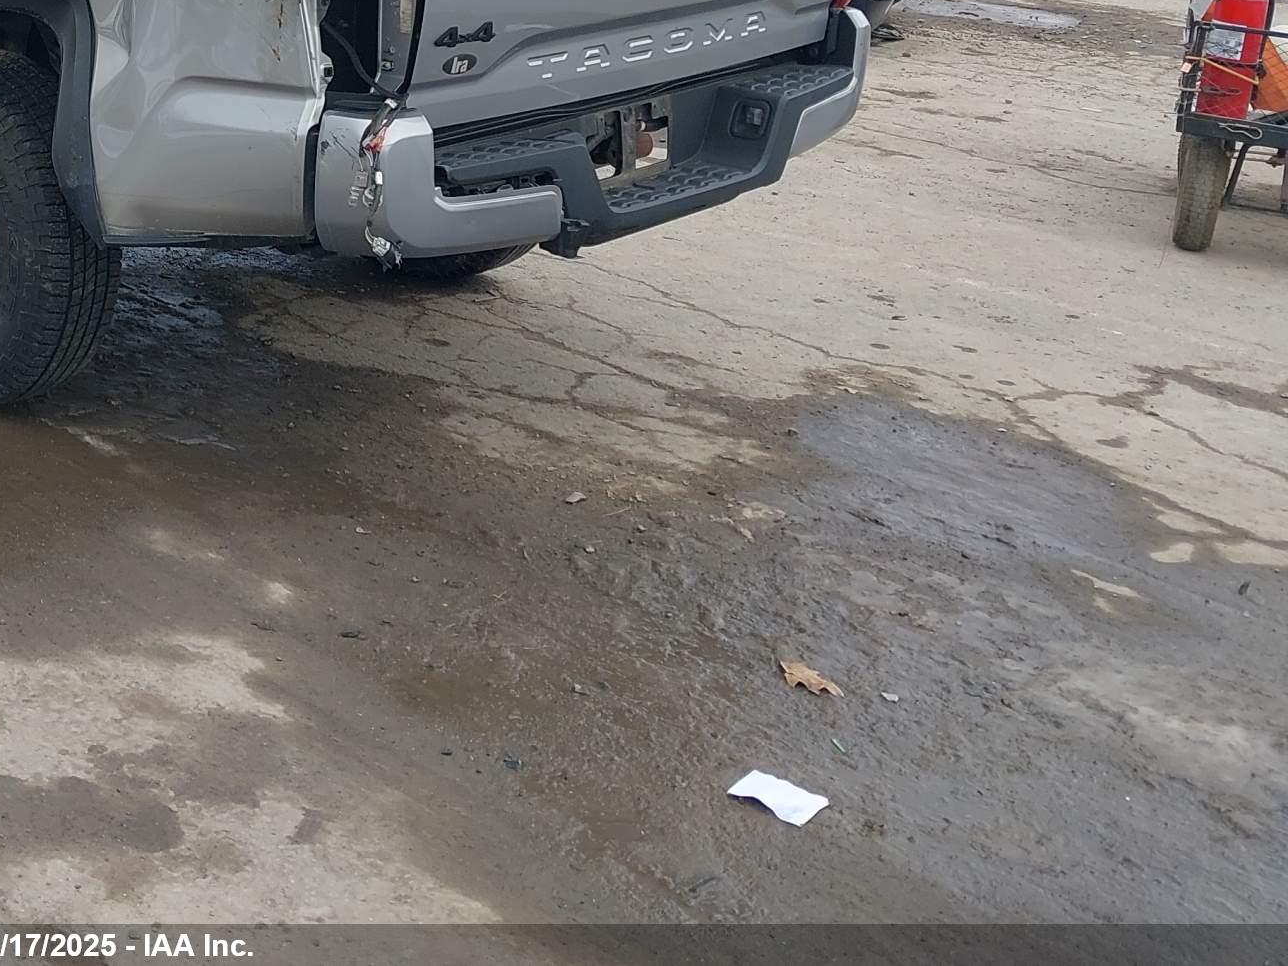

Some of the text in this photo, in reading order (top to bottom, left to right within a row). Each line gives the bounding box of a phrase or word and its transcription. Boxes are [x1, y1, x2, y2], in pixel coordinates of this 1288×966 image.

[433, 20, 496, 48] 4x4
[527, 10, 766, 79] TACOMA
[450, 56, 469, 74] Ira
